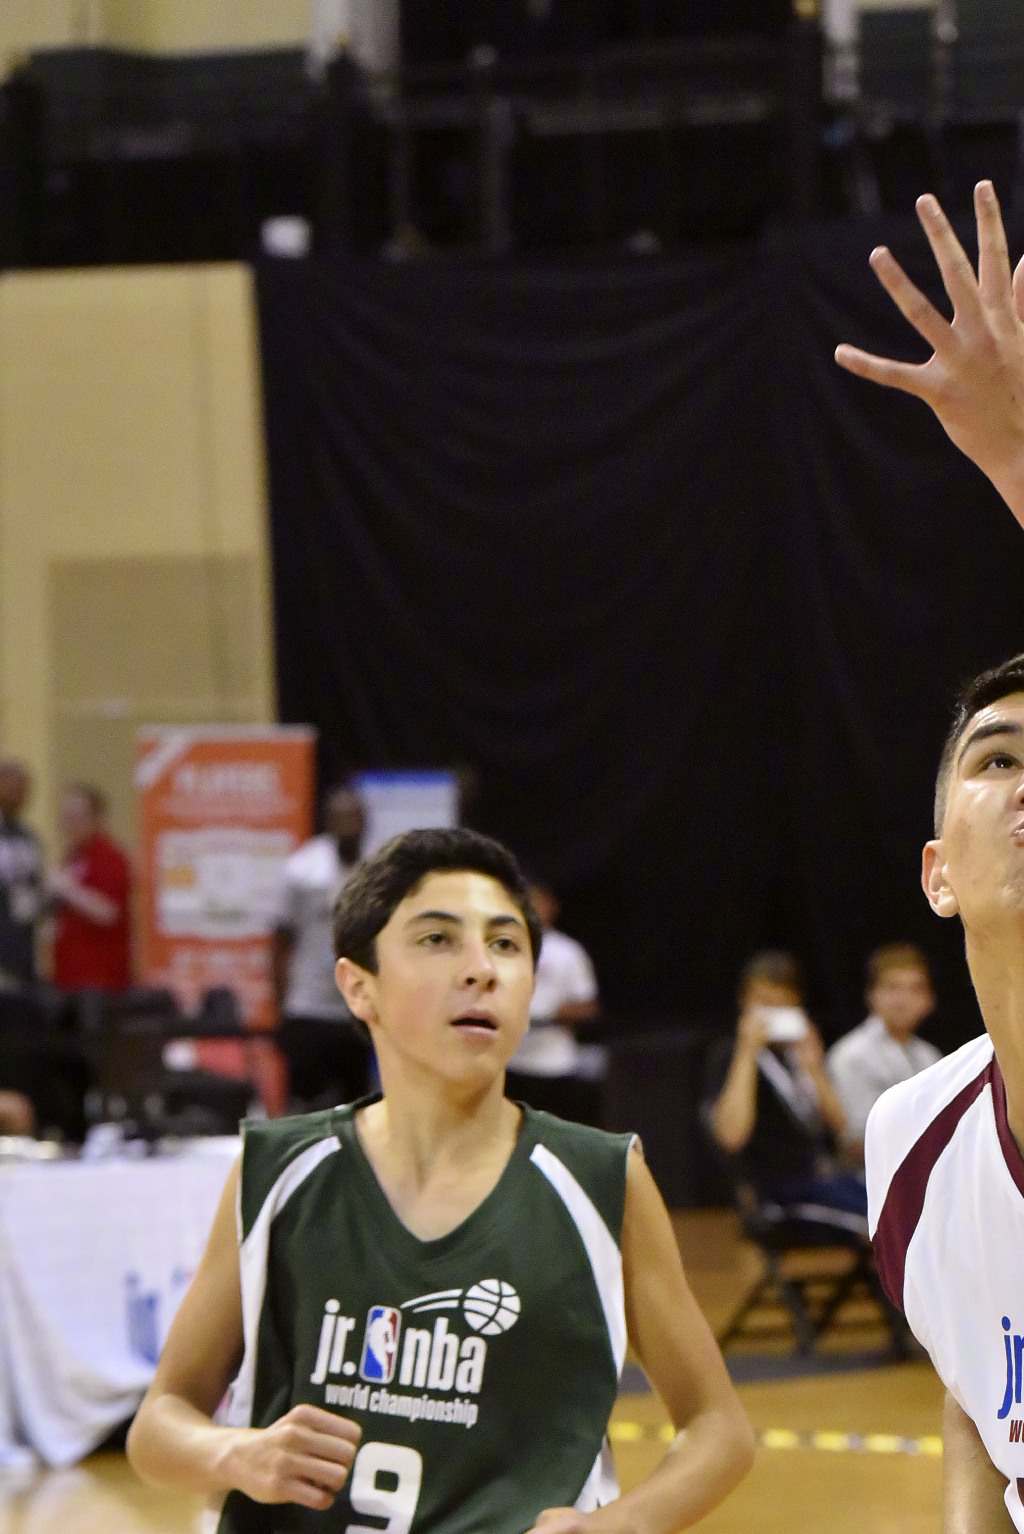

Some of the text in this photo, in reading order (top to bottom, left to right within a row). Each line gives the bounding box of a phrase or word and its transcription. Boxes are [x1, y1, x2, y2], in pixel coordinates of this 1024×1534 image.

[310, 1299, 488, 1394] jr. nba
[325, 1383, 479, 1429] world championship
